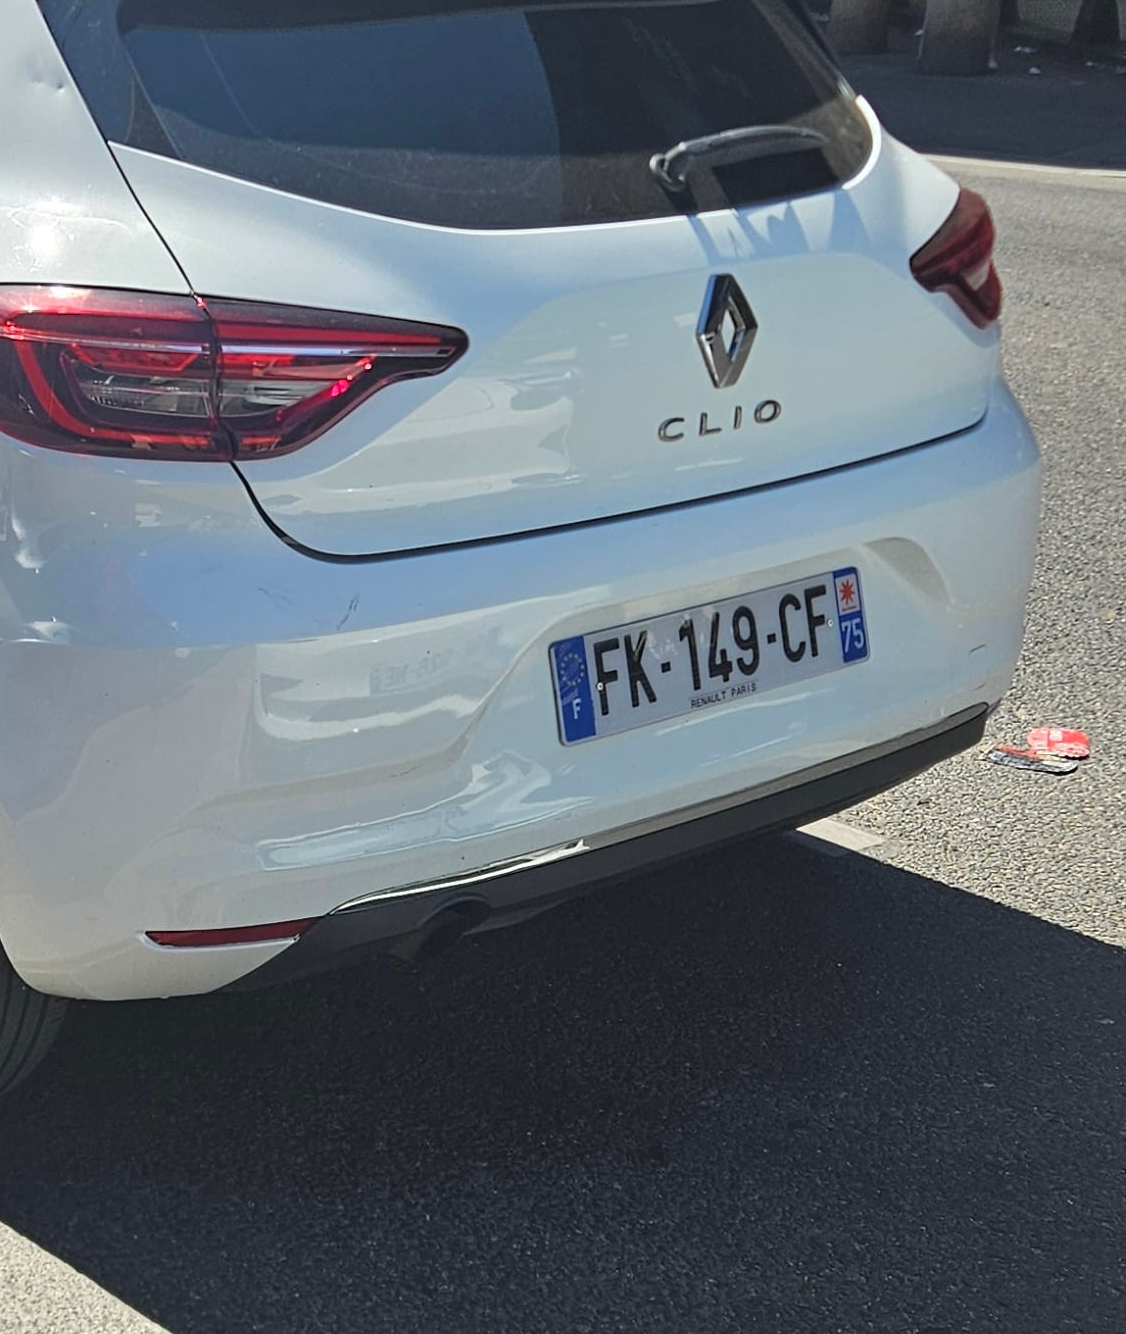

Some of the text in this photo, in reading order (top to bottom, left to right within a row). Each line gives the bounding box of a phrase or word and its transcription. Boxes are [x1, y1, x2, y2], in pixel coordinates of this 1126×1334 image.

[658, 399, 782, 442] CLIO
[572, 585, 827, 720] F FK-149-CF
[841, 618, 864, 654] 75
[691, 682, 757, 708] RENAULT PARIS
